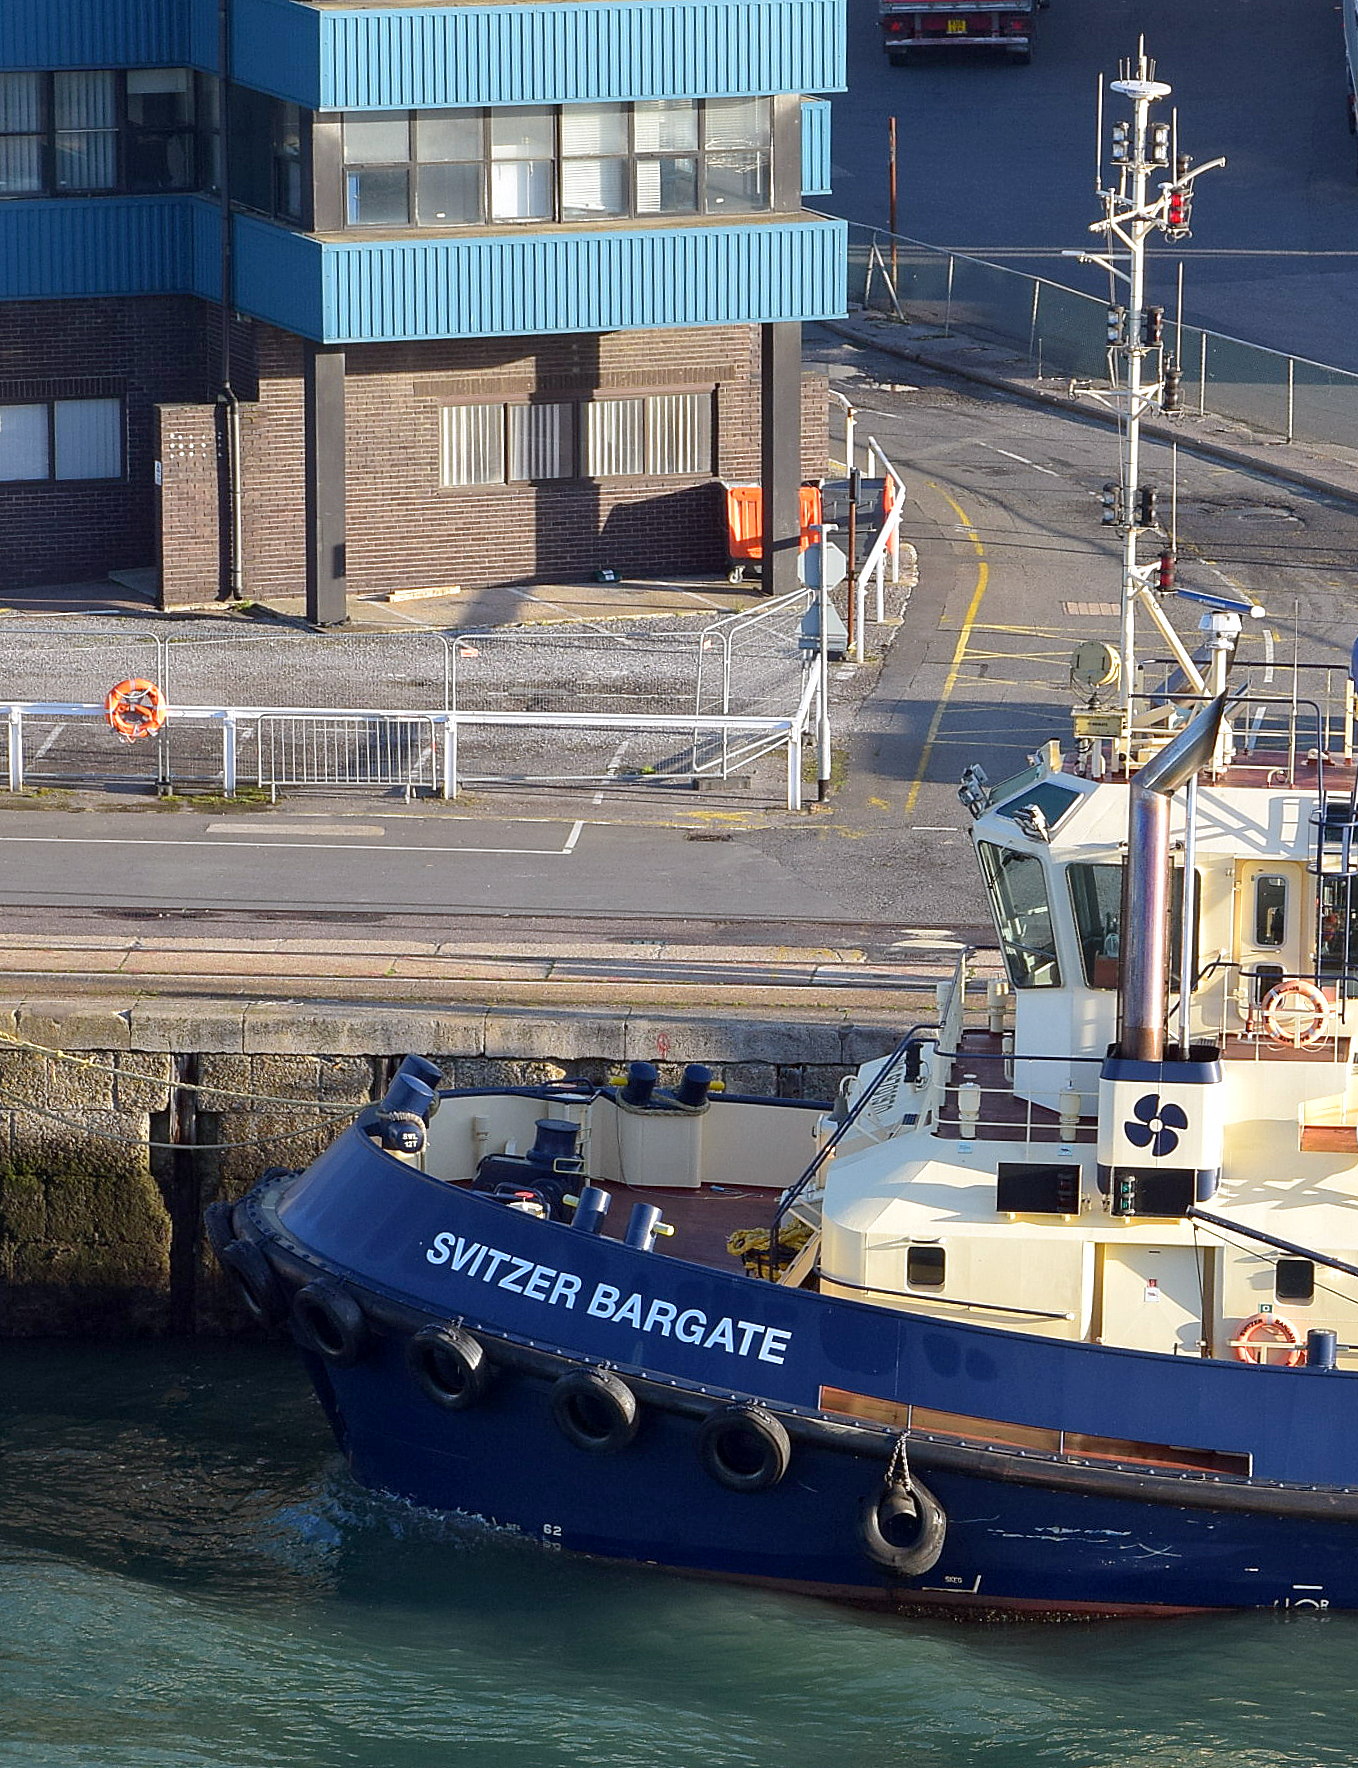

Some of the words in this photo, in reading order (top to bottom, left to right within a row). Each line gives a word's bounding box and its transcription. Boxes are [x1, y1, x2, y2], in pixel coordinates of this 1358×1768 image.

[425, 1231, 582, 1310] SVITZER
[586, 1282, 793, 1366] BARGATE
[543, 1523, 562, 1536] 62
